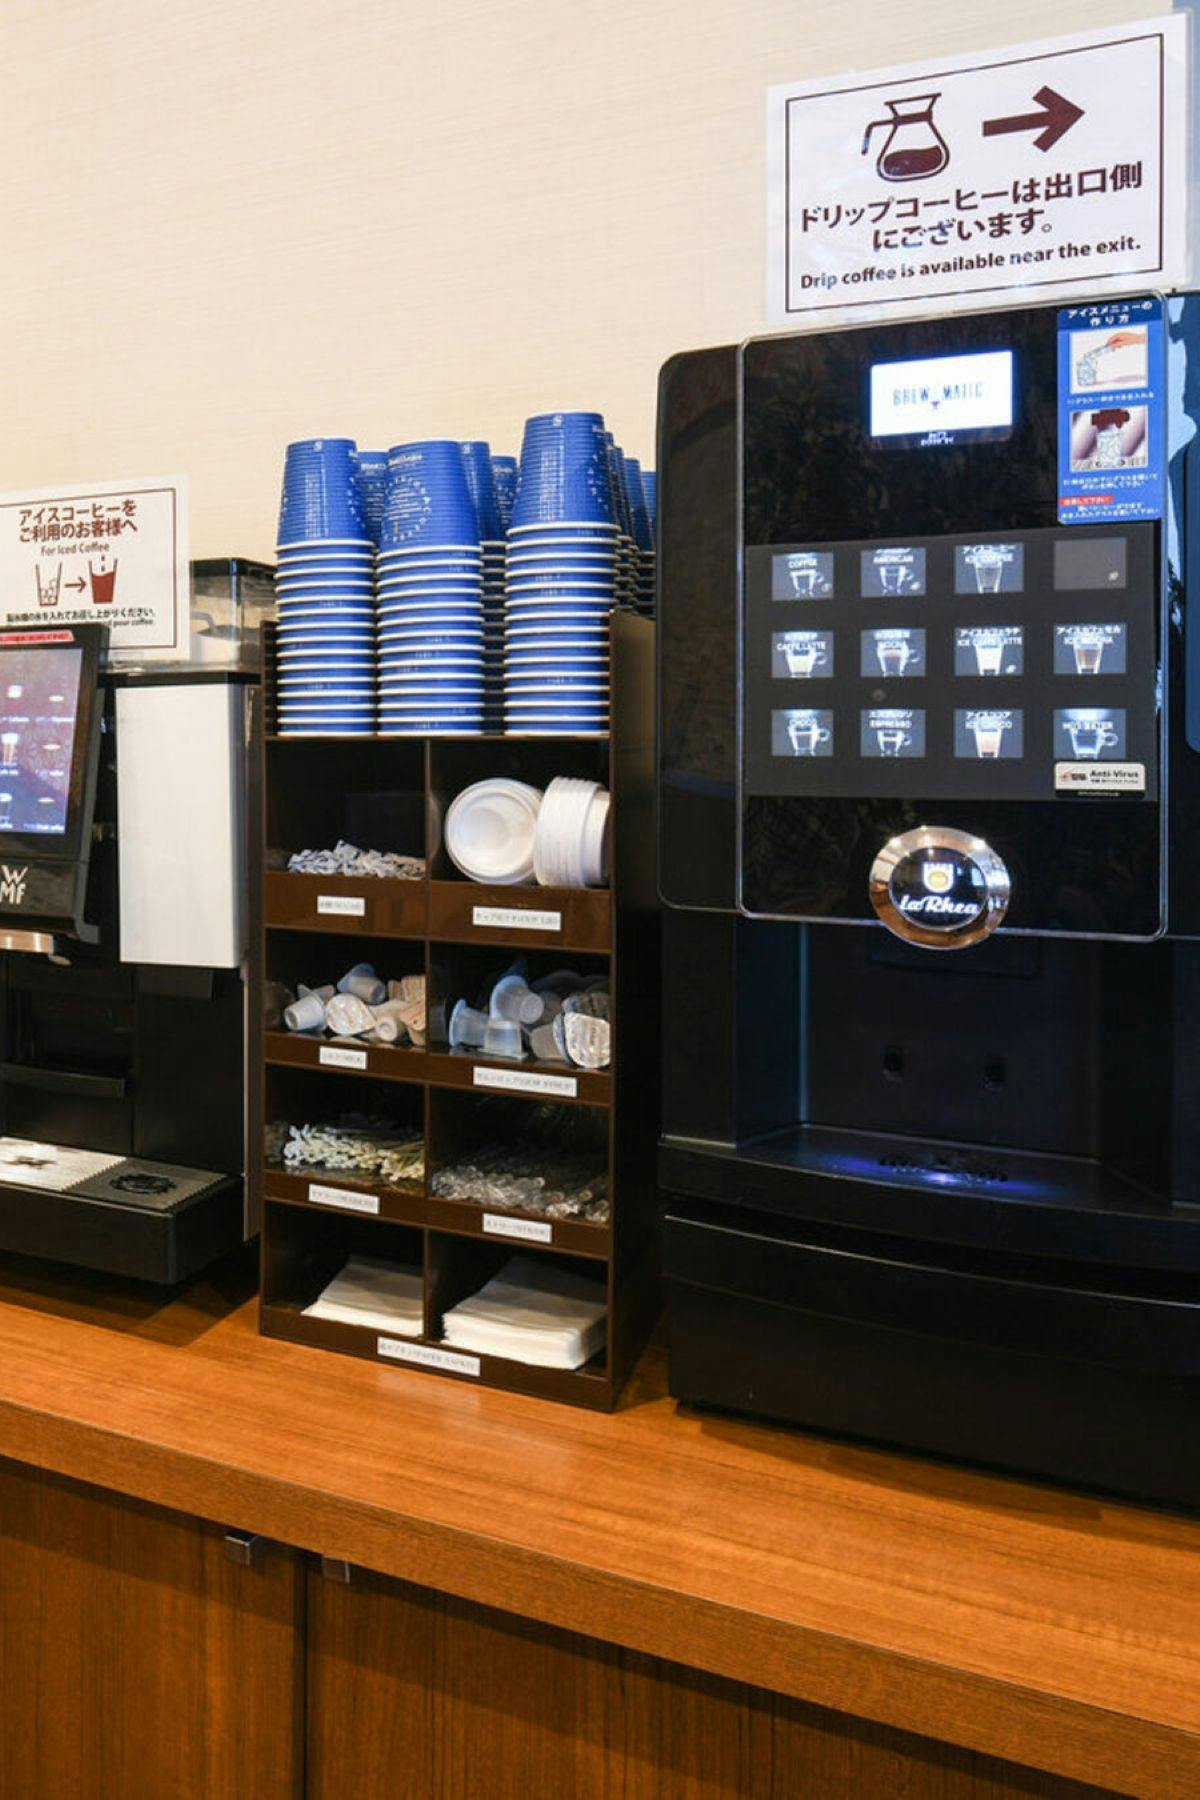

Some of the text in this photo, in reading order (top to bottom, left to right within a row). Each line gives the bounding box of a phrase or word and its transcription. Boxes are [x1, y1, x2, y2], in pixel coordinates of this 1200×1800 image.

[801, 161, 1143, 232] ドリップコーヒーは出口側
[873, 208, 1053, 252] にございます。
[801, 236, 1142, 289] Drip coffee is available near the exit.
[19, 499, 137, 526] アイスコーヒーを
[19, 518, 138, 543] ご利用のお客様へ
[40, 544, 55, 555] For
[79, 541, 110, 553] Coffee
